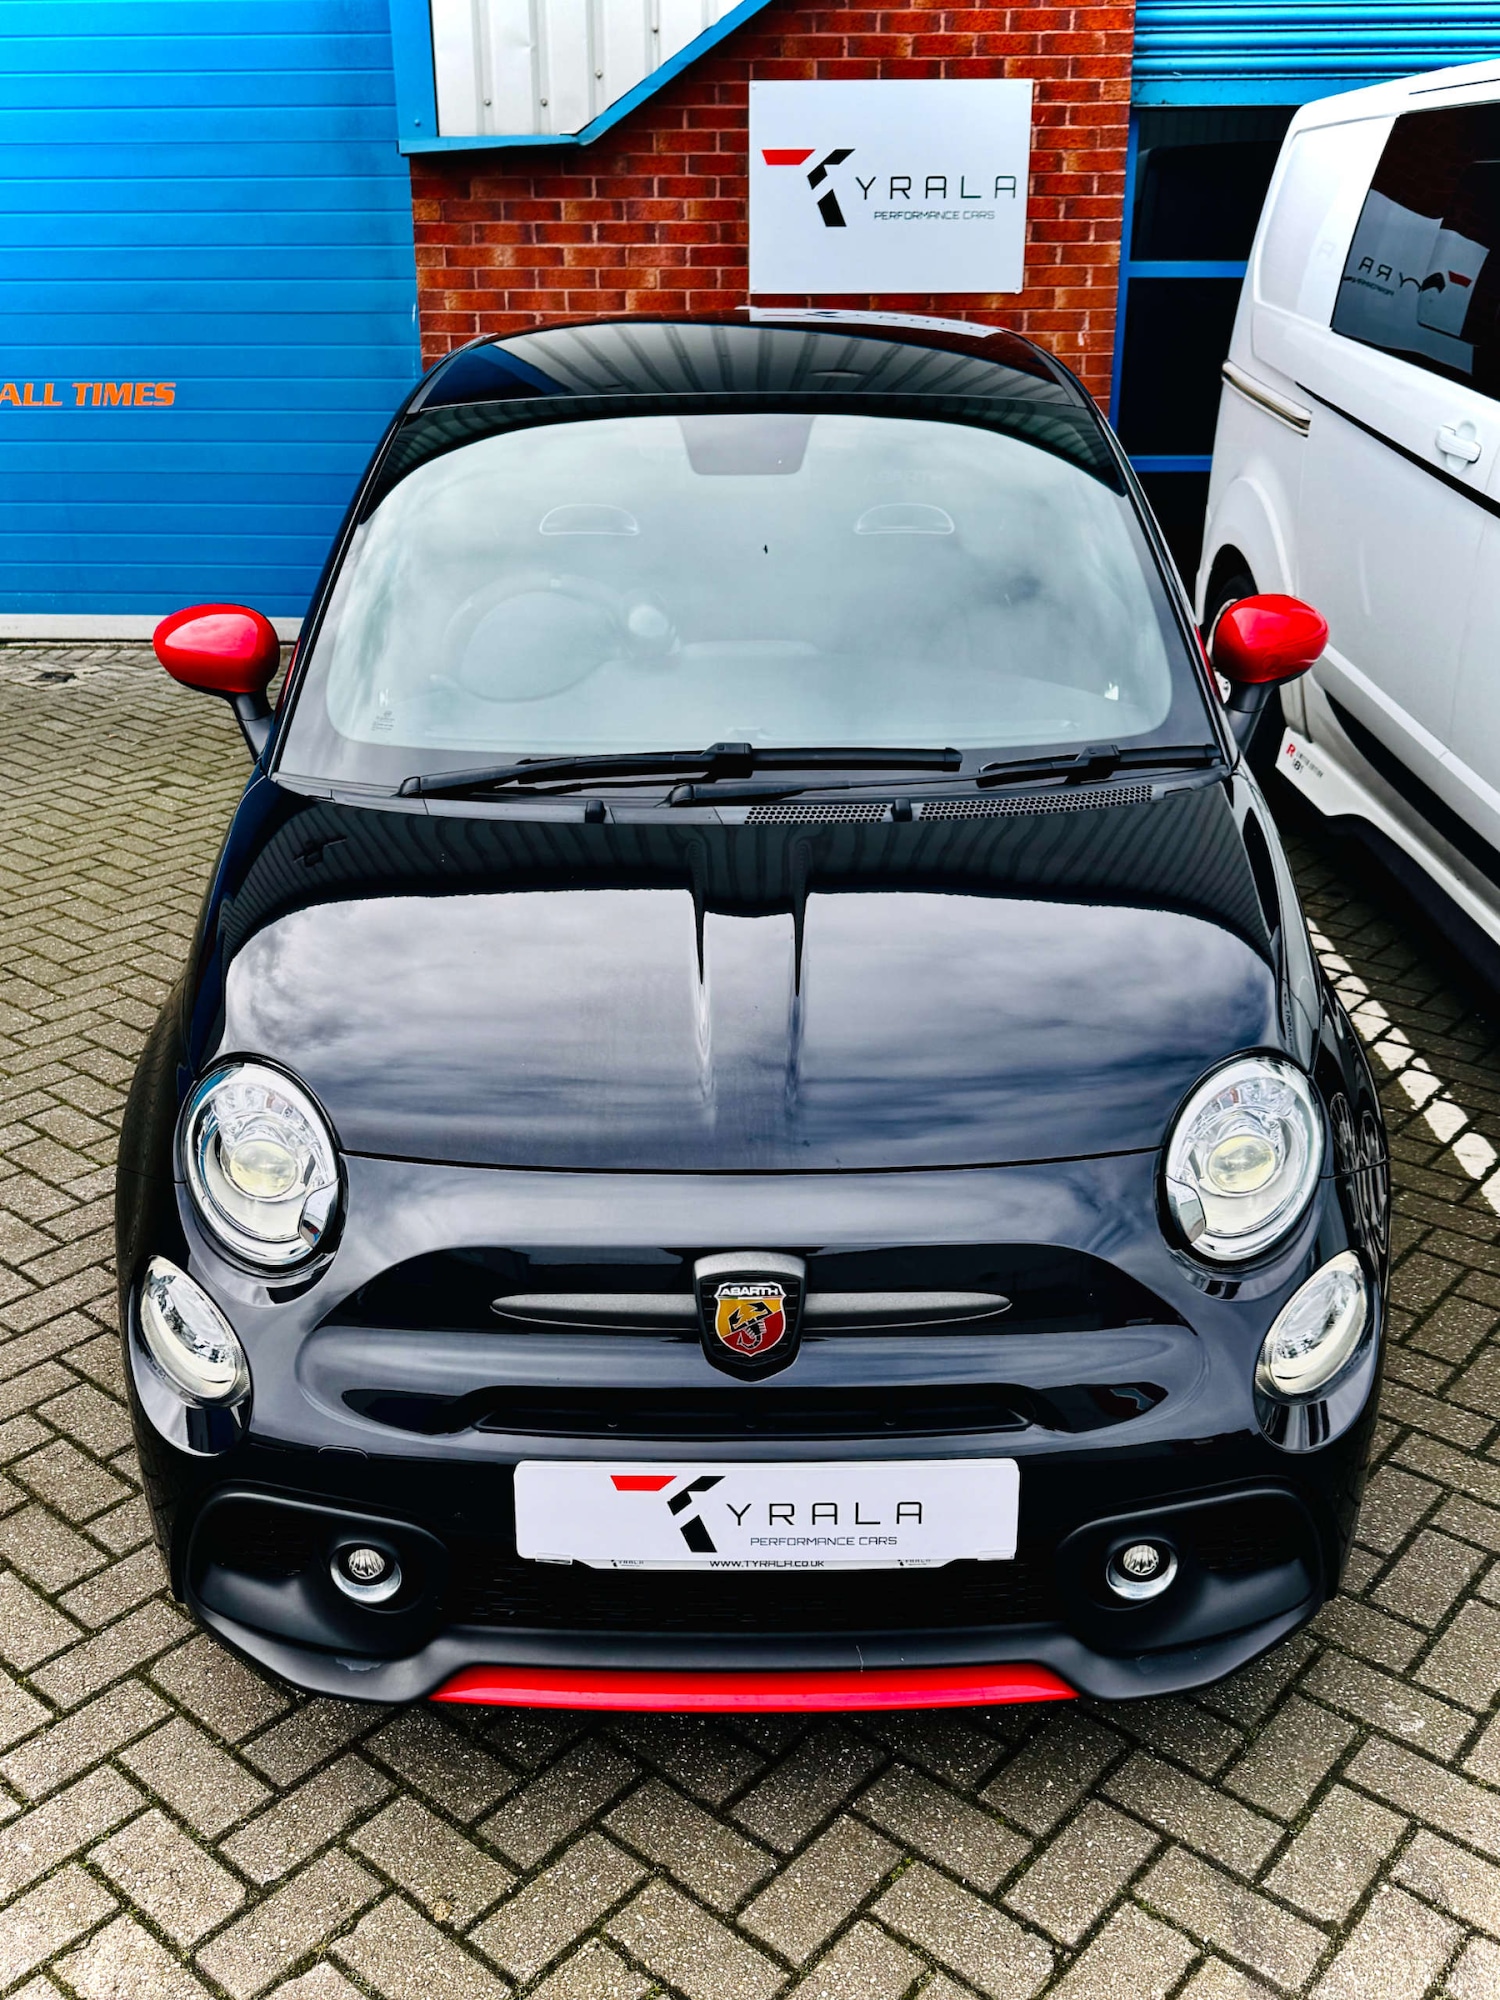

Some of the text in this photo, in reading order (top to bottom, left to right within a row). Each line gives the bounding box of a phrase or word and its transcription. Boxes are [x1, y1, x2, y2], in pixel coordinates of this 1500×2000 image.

[874, 211, 995, 221] PERFORMANCE CARS
[0, 383, 176, 406] ALL TIMES
[720, 1287, 778, 1295] ABARTH
[750, 1536, 898, 1546] PERFORMANCE CARS
